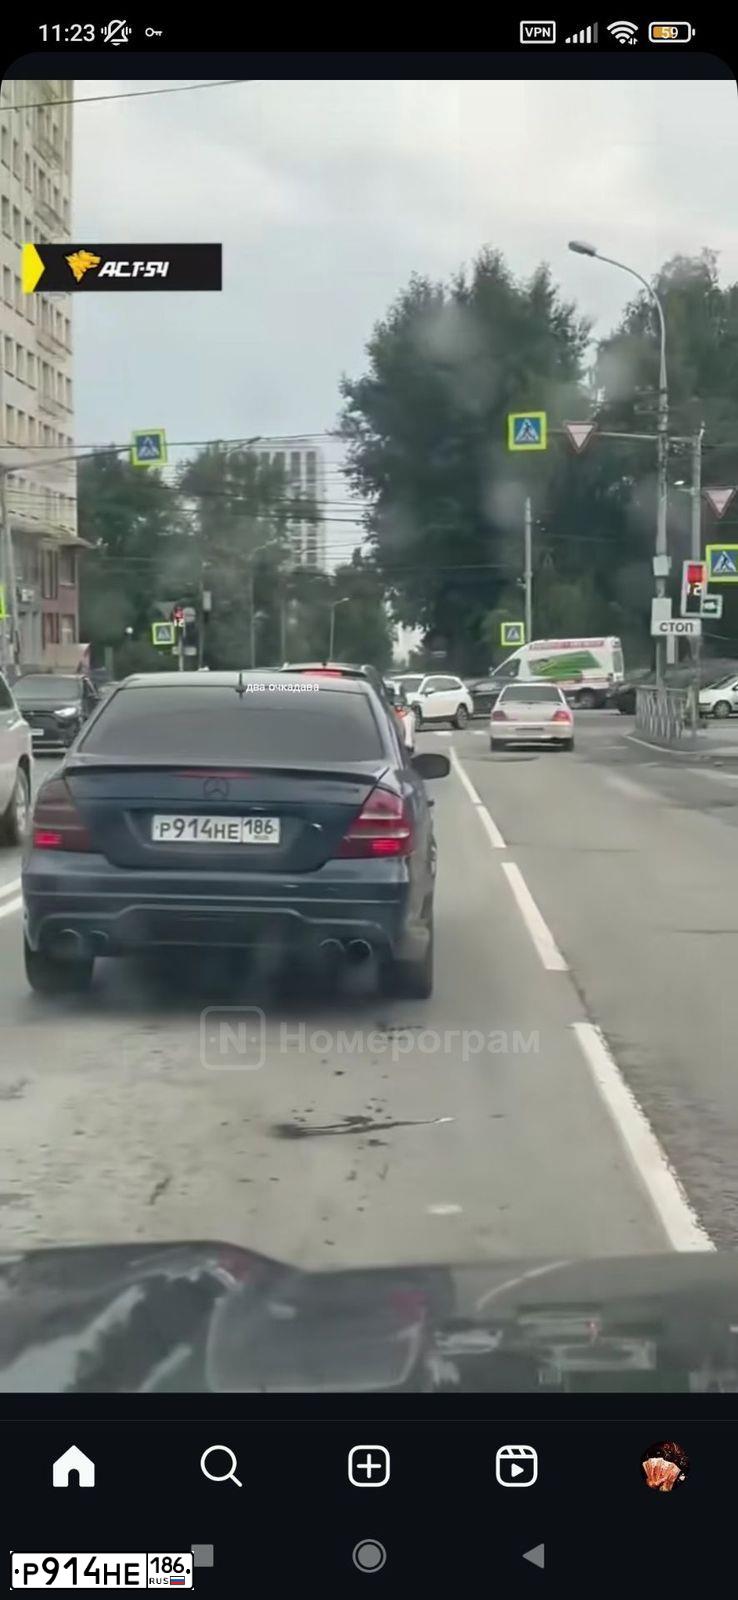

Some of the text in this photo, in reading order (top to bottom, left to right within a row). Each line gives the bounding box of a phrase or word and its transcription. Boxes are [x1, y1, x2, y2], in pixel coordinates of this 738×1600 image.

[660, 622, 694, 632] СТОП
[160, 817, 274, 840] Р914НЕ 186
